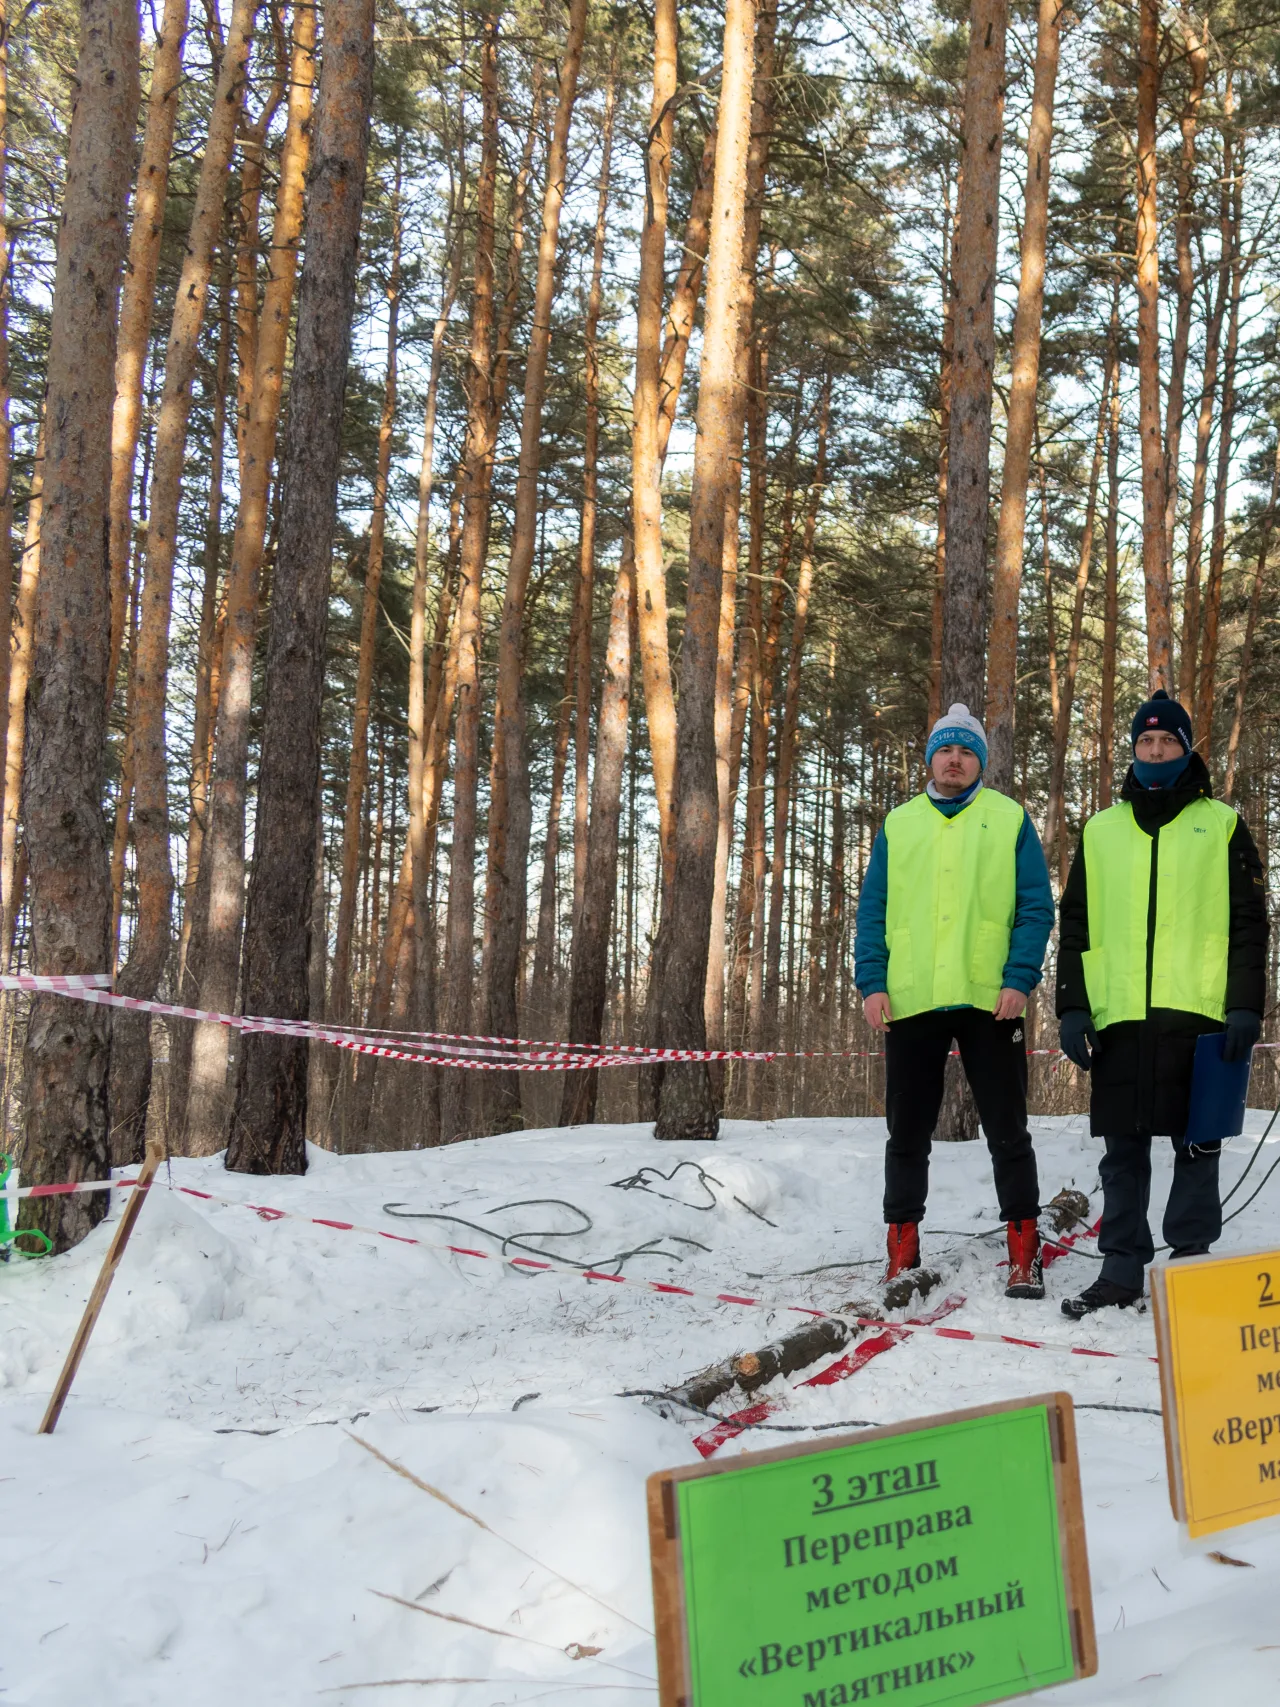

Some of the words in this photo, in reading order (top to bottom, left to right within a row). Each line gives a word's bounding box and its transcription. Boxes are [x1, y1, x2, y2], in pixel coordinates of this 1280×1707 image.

[1257, 1272, 1273, 1302] 2
[811, 1473, 834, 1509] 3
[847, 1459, 940, 1502] этап
[782, 1504, 974, 1568] Переправа
[805, 1555, 959, 1613] методом
[737, 1580, 1026, 1680] «Вертикальный
[803, 1650, 976, 1707] маятник»
